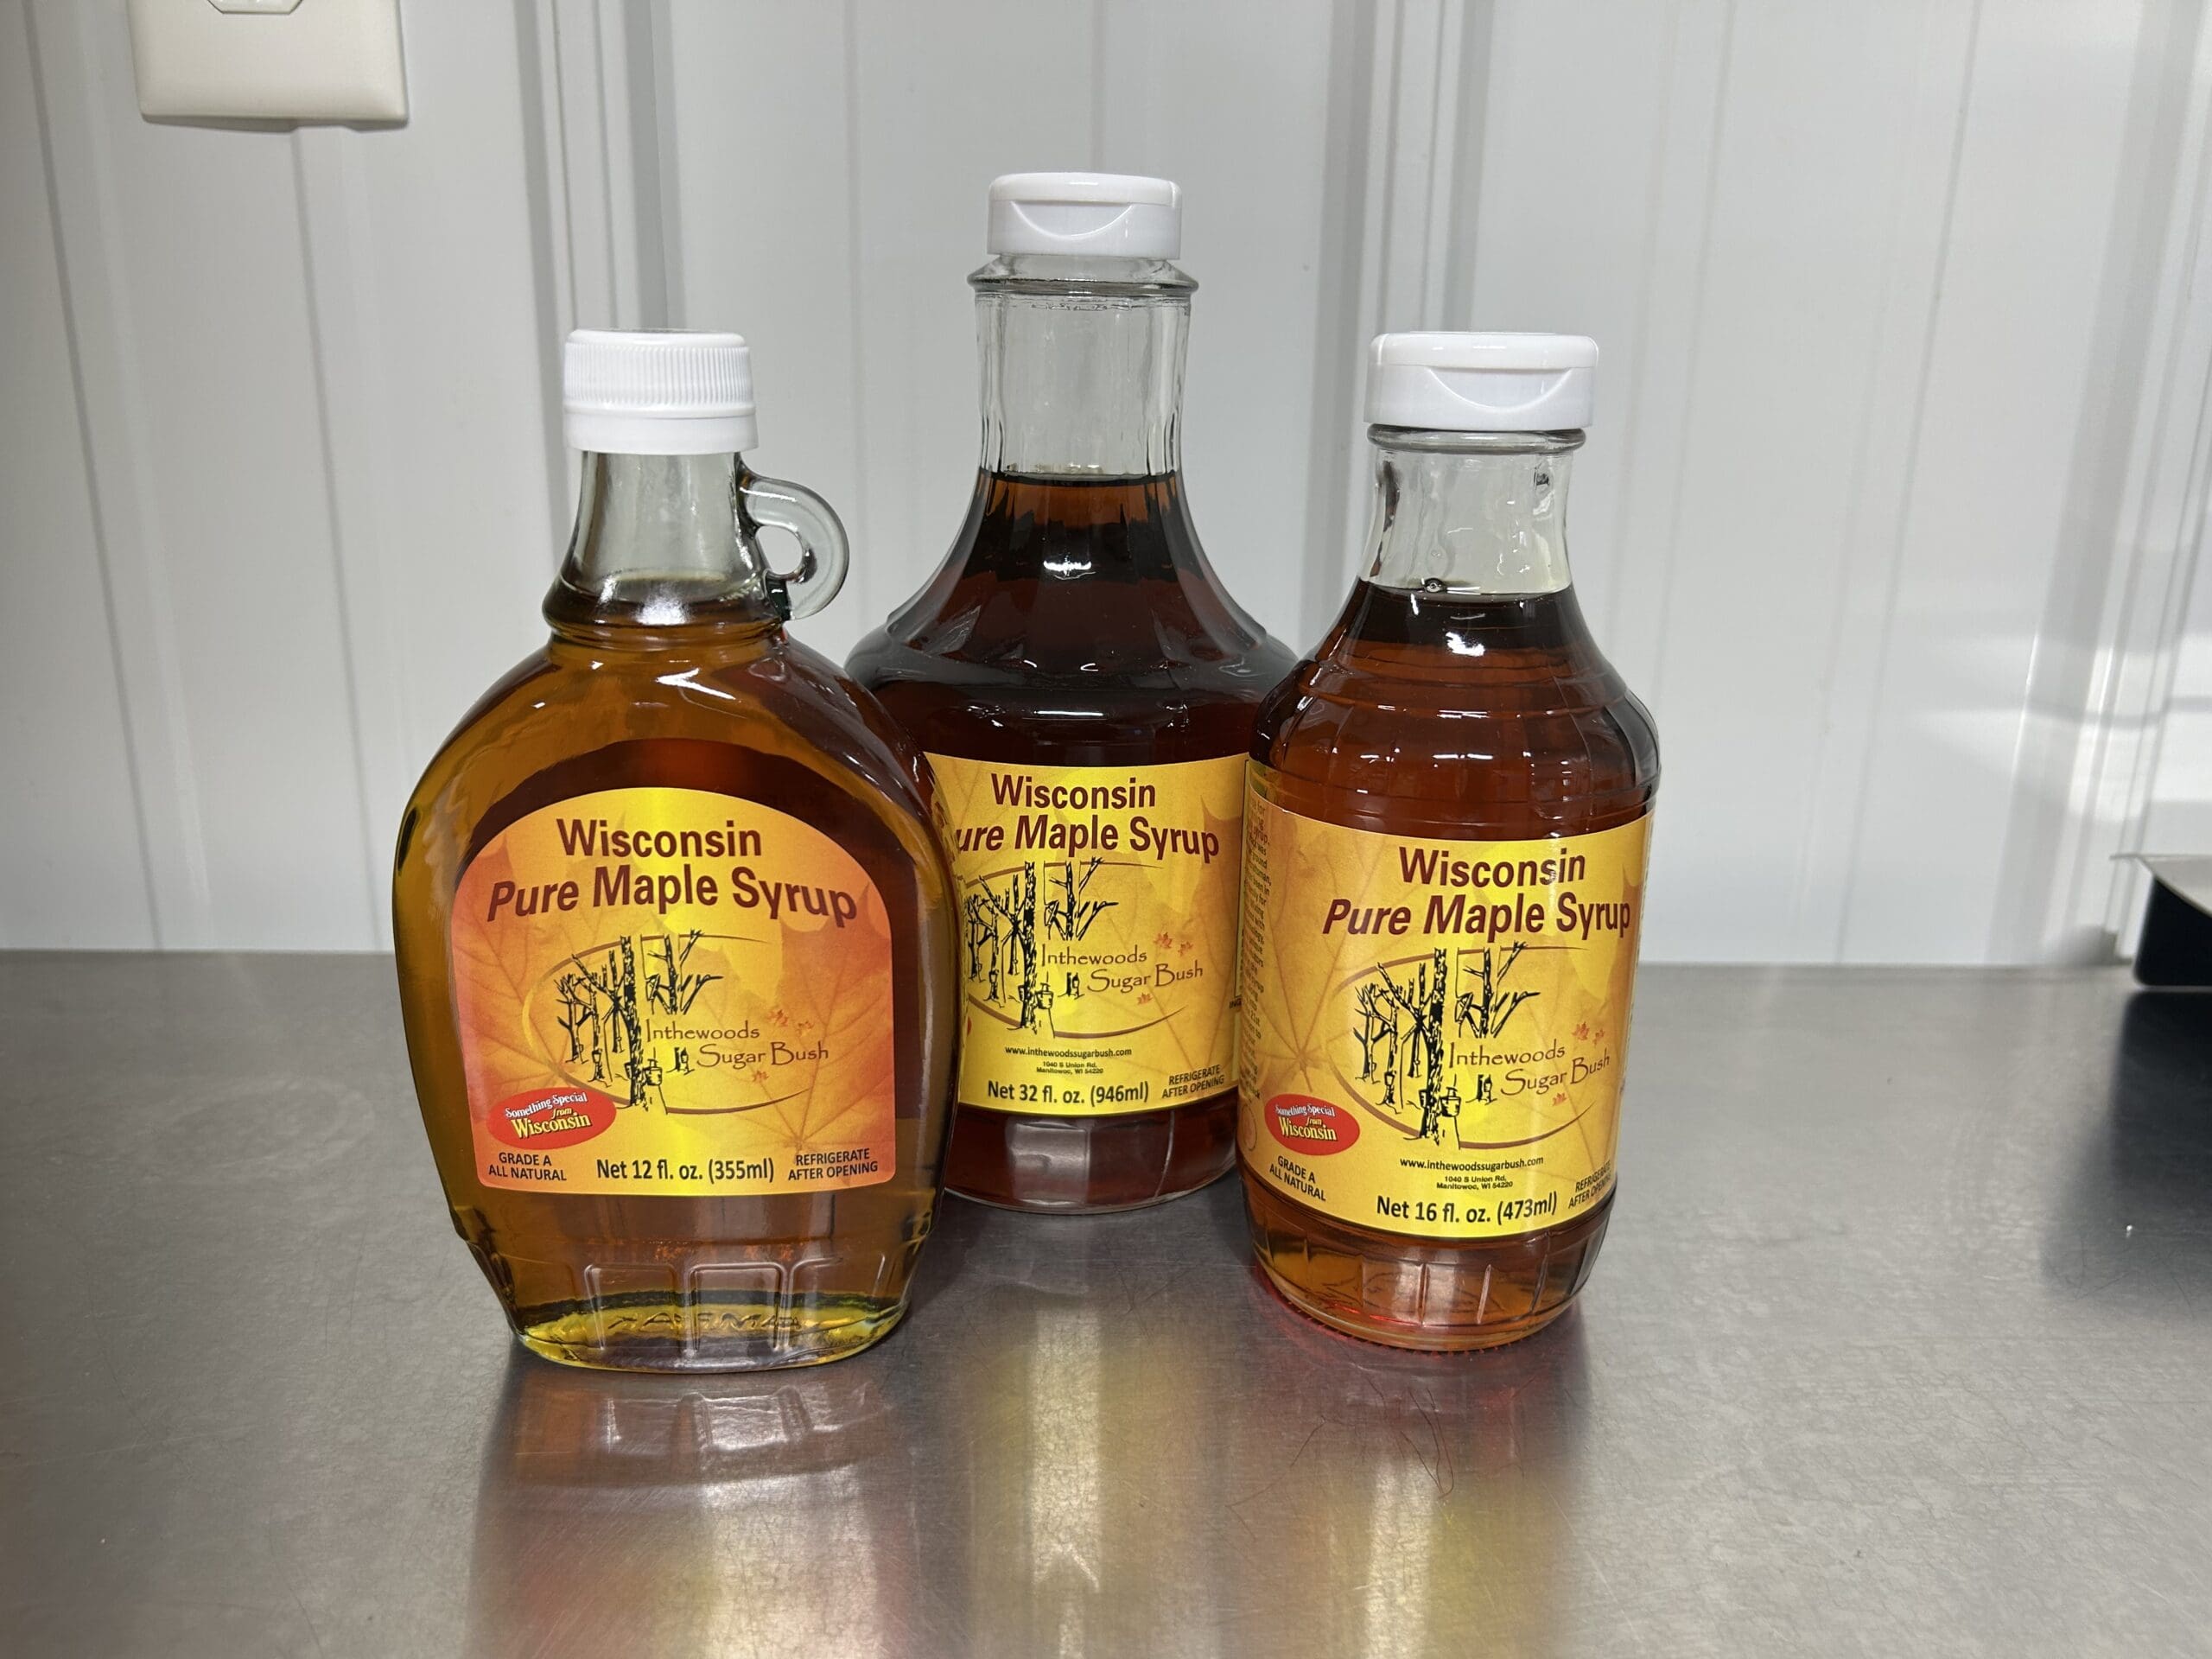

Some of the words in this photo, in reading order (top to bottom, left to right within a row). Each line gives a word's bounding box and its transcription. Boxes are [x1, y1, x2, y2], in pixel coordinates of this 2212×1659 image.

[991, 773, 1155, 809] Wisconsin
[556, 818, 761, 856] Wisconsin
[956, 824, 1005, 852] ure
[1014, 814, 1119, 857] Maple
[1129, 817, 1219, 863] Syrup
[1399, 847, 1586, 888] Wisconsin
[487, 875, 579, 922] Pure
[594, 865, 718, 914] Maple
[734, 867, 857, 927] Syrup
[1322, 898, 1411, 936] Pure
[1422, 893, 1545, 944] Maple
[1556, 892, 1630, 941] Syrup
[1042, 944, 1147, 967] Inthewoods
[1087, 968, 1151, 993] Sugar
[1154, 961, 1204, 988] Bush
[645, 1019, 760, 1043] Inthewoods
[696, 1045, 766, 1070] Sugar
[771, 1042, 829, 1065] Bush
[1005, 1046, 1132, 1059] www.inthewoodssugarbush.com
[1448, 1039, 1566, 1069] Inthewoods
[1161, 1085, 1189, 1098] AFTER
[1190, 1074, 1224, 1093] OPENING
[1169, 1064, 1220, 1085] REFRIGERATE
[1500, 1068, 1567, 1098] Sugar
[1570, 1053, 1610, 1085] Bush
[505, 1098, 552, 1117] Something
[552, 1092, 588, 1105] Special
[988, 1080, 1015, 1099] Net
[1019, 1084, 1037, 1101] 32
[1043, 1085, 1057, 1103] fl.
[1063, 1090, 1084, 1103] oz.
[1090, 1081, 1149, 1107] (946ml)
[552, 1108, 571, 1119] from
[1275, 1104, 1306, 1117] Something
[1307, 1104, 1335, 1116] Special
[1306, 1116, 1322, 1126] from
[511, 1112, 591, 1138] Wisconsin
[1279, 1116, 1338, 1141] Wisconsin
[499, 1152, 539, 1166] GRADE
[543, 1154, 552, 1166] A
[796, 1148, 870, 1166] REFRIGERATE
[1277, 1155, 1306, 1179] GRADE
[1308, 1172, 1316, 1184] A
[1400, 1156, 1544, 1173] www.inthewoodssugarbush.com
[488, 1164, 508, 1177] ALL
[511, 1167, 567, 1181] NATURAL
[596, 1159, 627, 1179] Net
[632, 1160, 652, 1179] 12
[658, 1160, 673, 1179] fl.
[679, 1165, 702, 1179] oz.
[709, 1158, 774, 1184] (355ml)
[788, 1167, 823, 1181] AFTER
[826, 1160, 878, 1179] OPENING
[1269, 1163, 1282, 1180] ALL
[1284, 1173, 1326, 1201] NATURAL
[1436, 1182, 1479, 1191] Manitowoc,
[1568, 1189, 1590, 1209] AFTER
[1376, 1195, 1409, 1219] Net
[1415, 1202, 1437, 1222] 16
[1442, 1203, 1459, 1223] fl.
[1466, 1208, 1491, 1223] oz.
[1497, 1191, 1557, 1225] (473ml)
